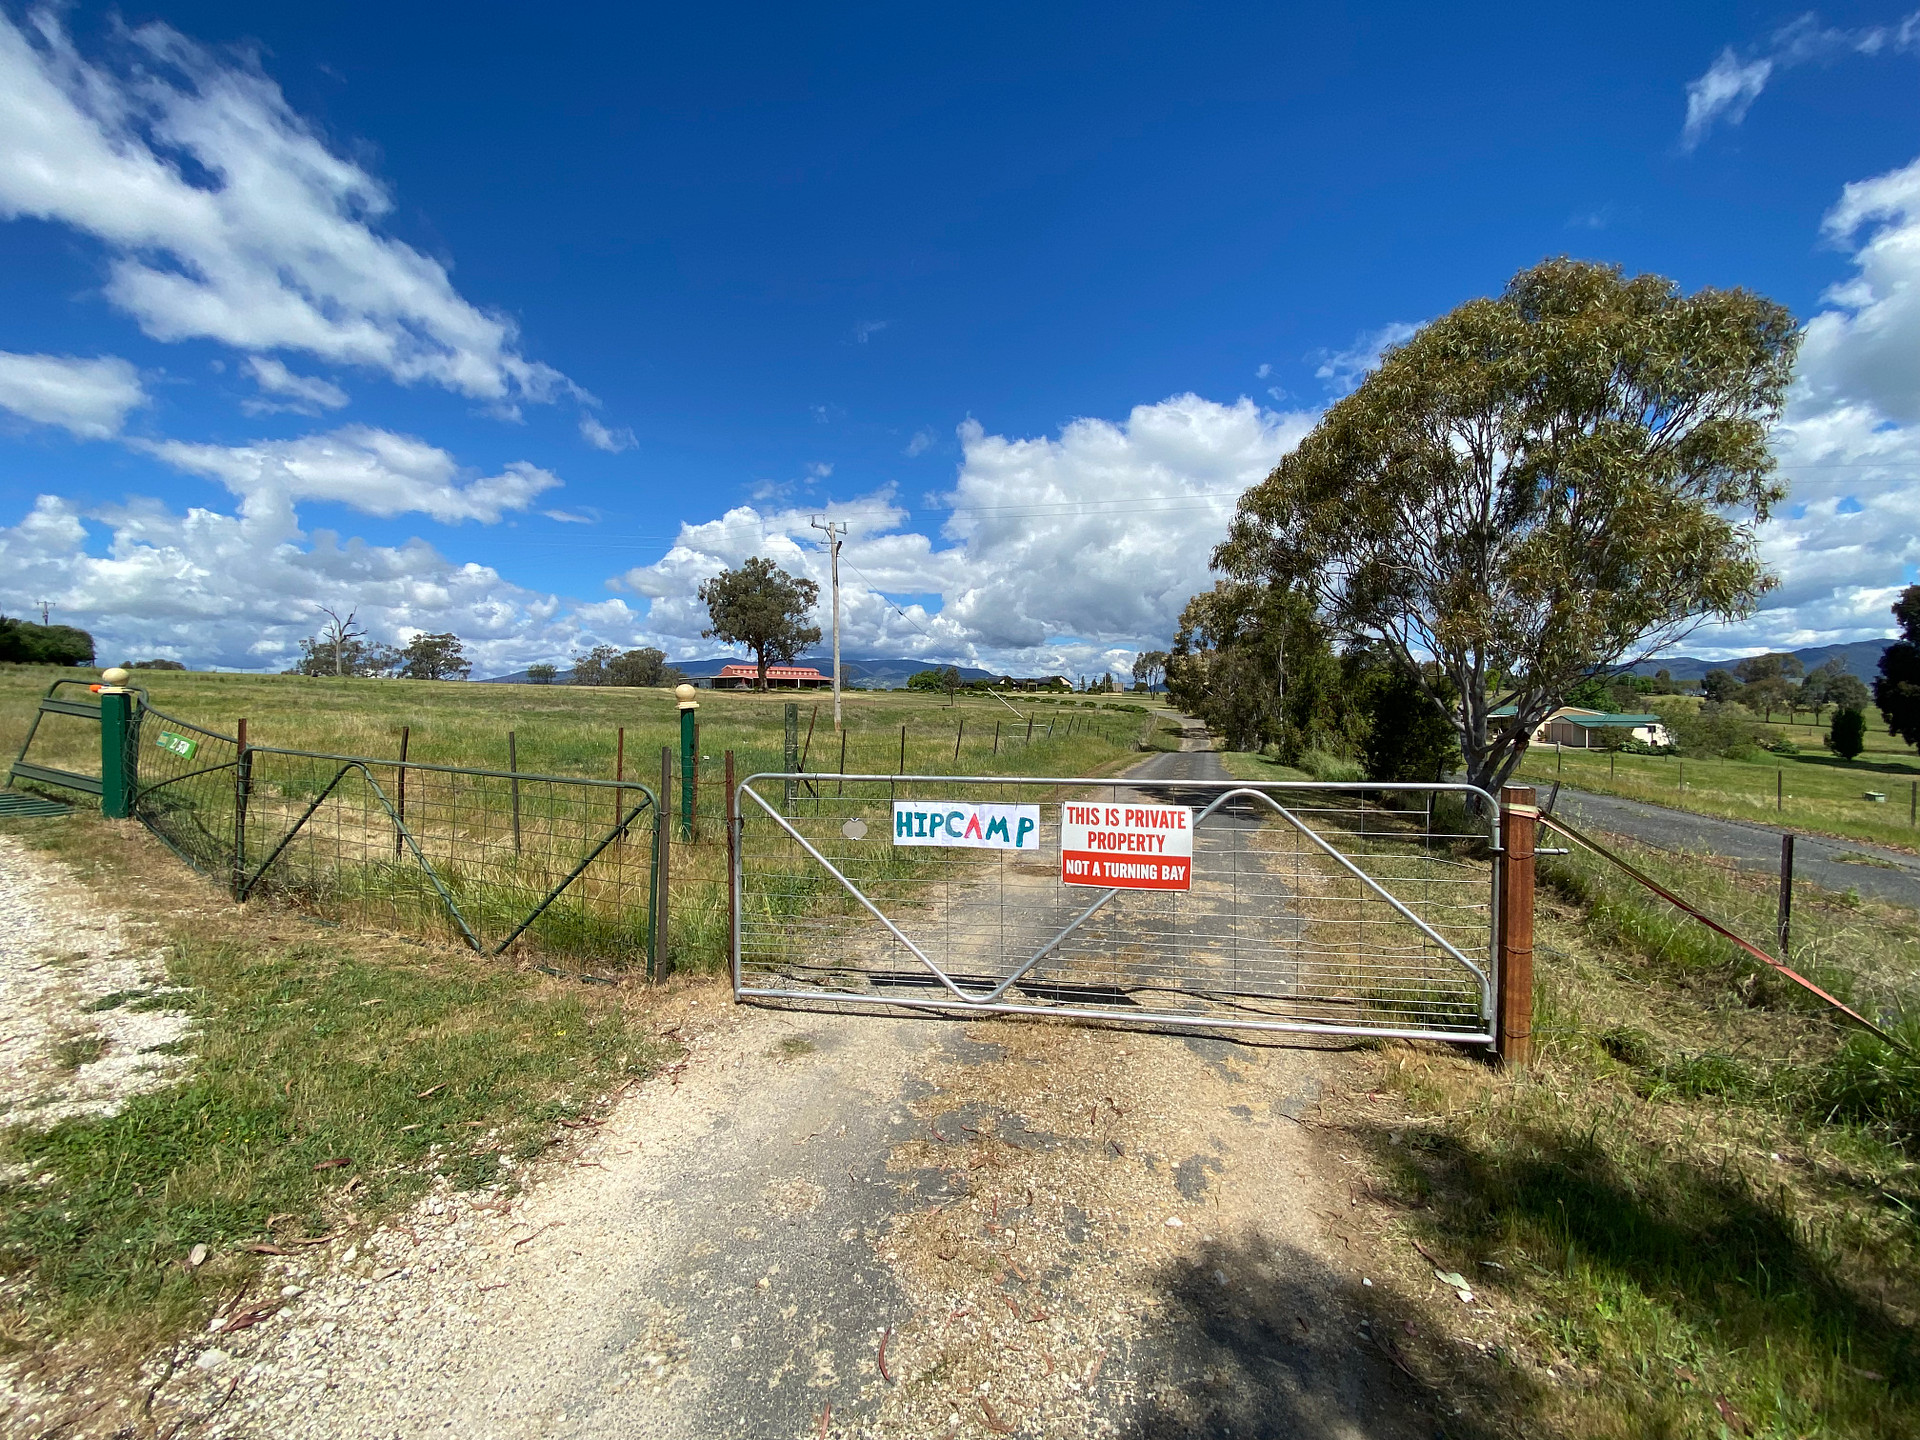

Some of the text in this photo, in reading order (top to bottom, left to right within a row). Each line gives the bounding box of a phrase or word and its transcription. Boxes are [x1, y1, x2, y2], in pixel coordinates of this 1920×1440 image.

[896, 811, 1035, 848] HIPCAMP
[1066, 806, 1187, 830] THIS IS PRIVATE
[1087, 831, 1166, 853] PROPERTY
[1066, 859, 1186, 881] NOT A TURNING BAY
